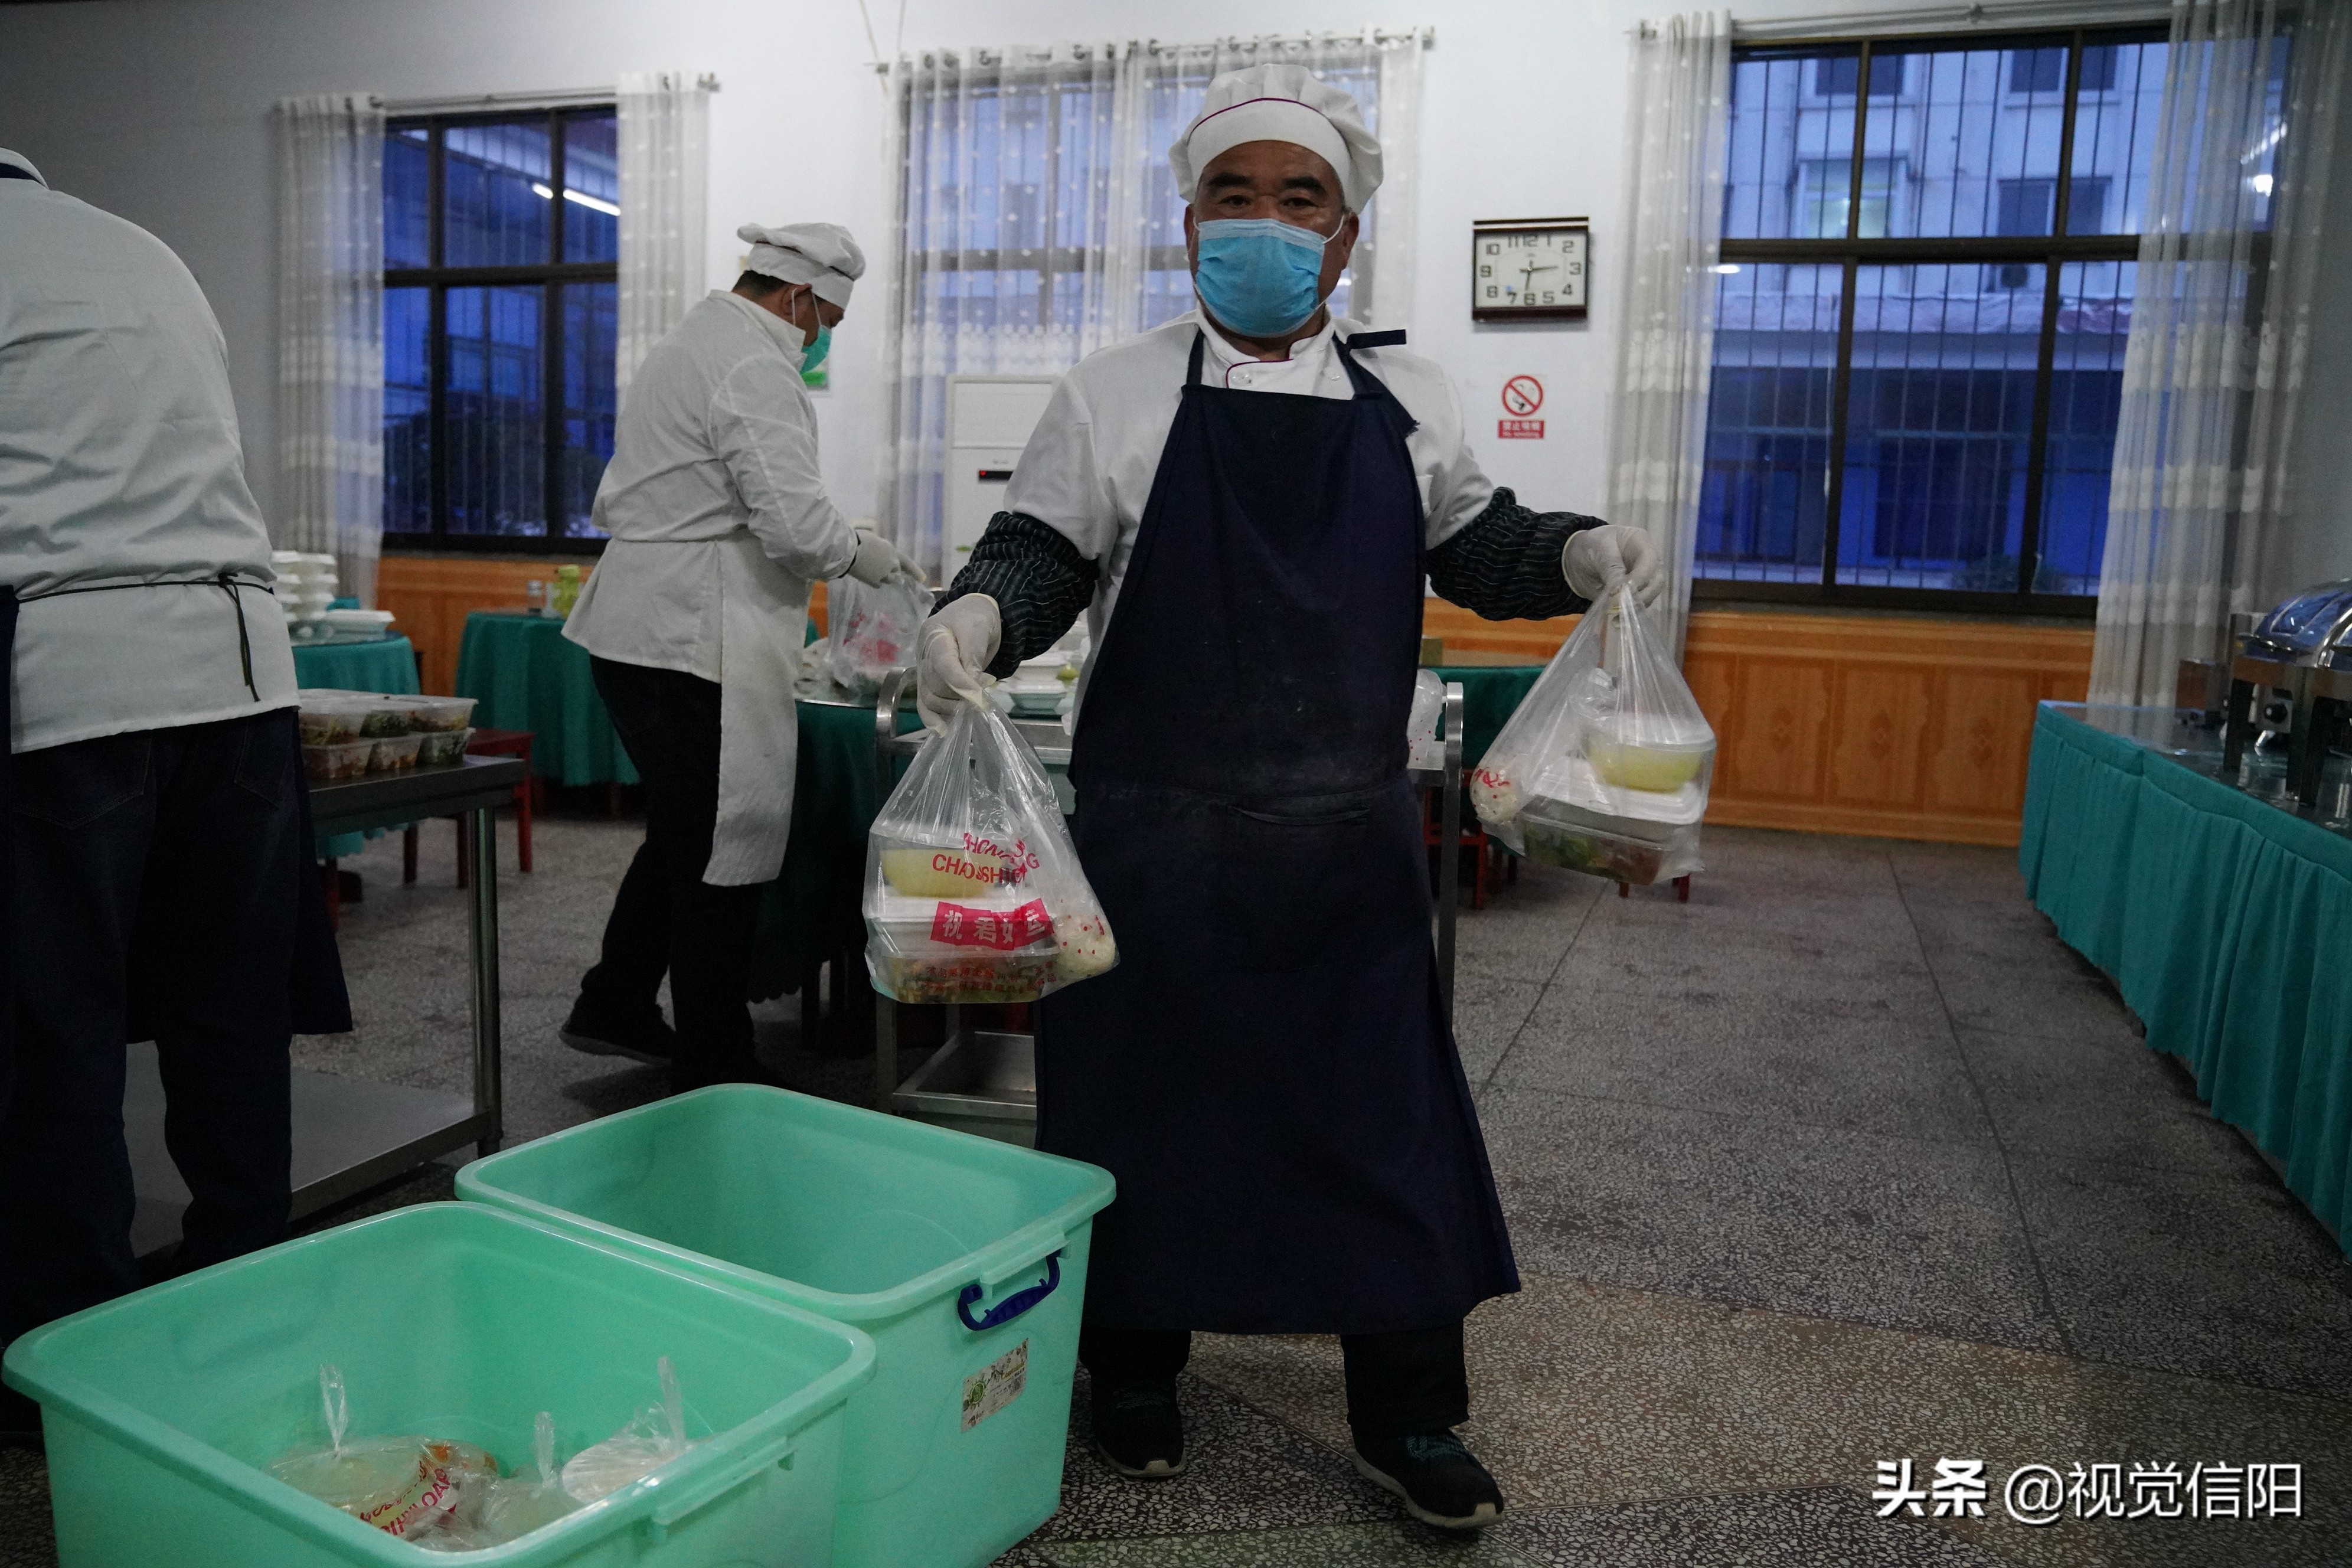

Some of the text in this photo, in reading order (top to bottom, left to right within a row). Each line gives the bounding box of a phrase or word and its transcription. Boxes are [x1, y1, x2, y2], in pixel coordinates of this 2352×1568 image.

[1523, 234, 1539, 247] 12
[1562, 240, 1574, 253] 2
[1479, 265, 1492, 277] 9
[1569, 262, 1582, 275] 3
[1487, 286, 1498, 298] 8
[1562, 282, 1573, 296] 4
[1507, 290, 1518, 304] 7
[1523, 292, 1536, 306] 6
[1542, 290, 1555, 305] 5
